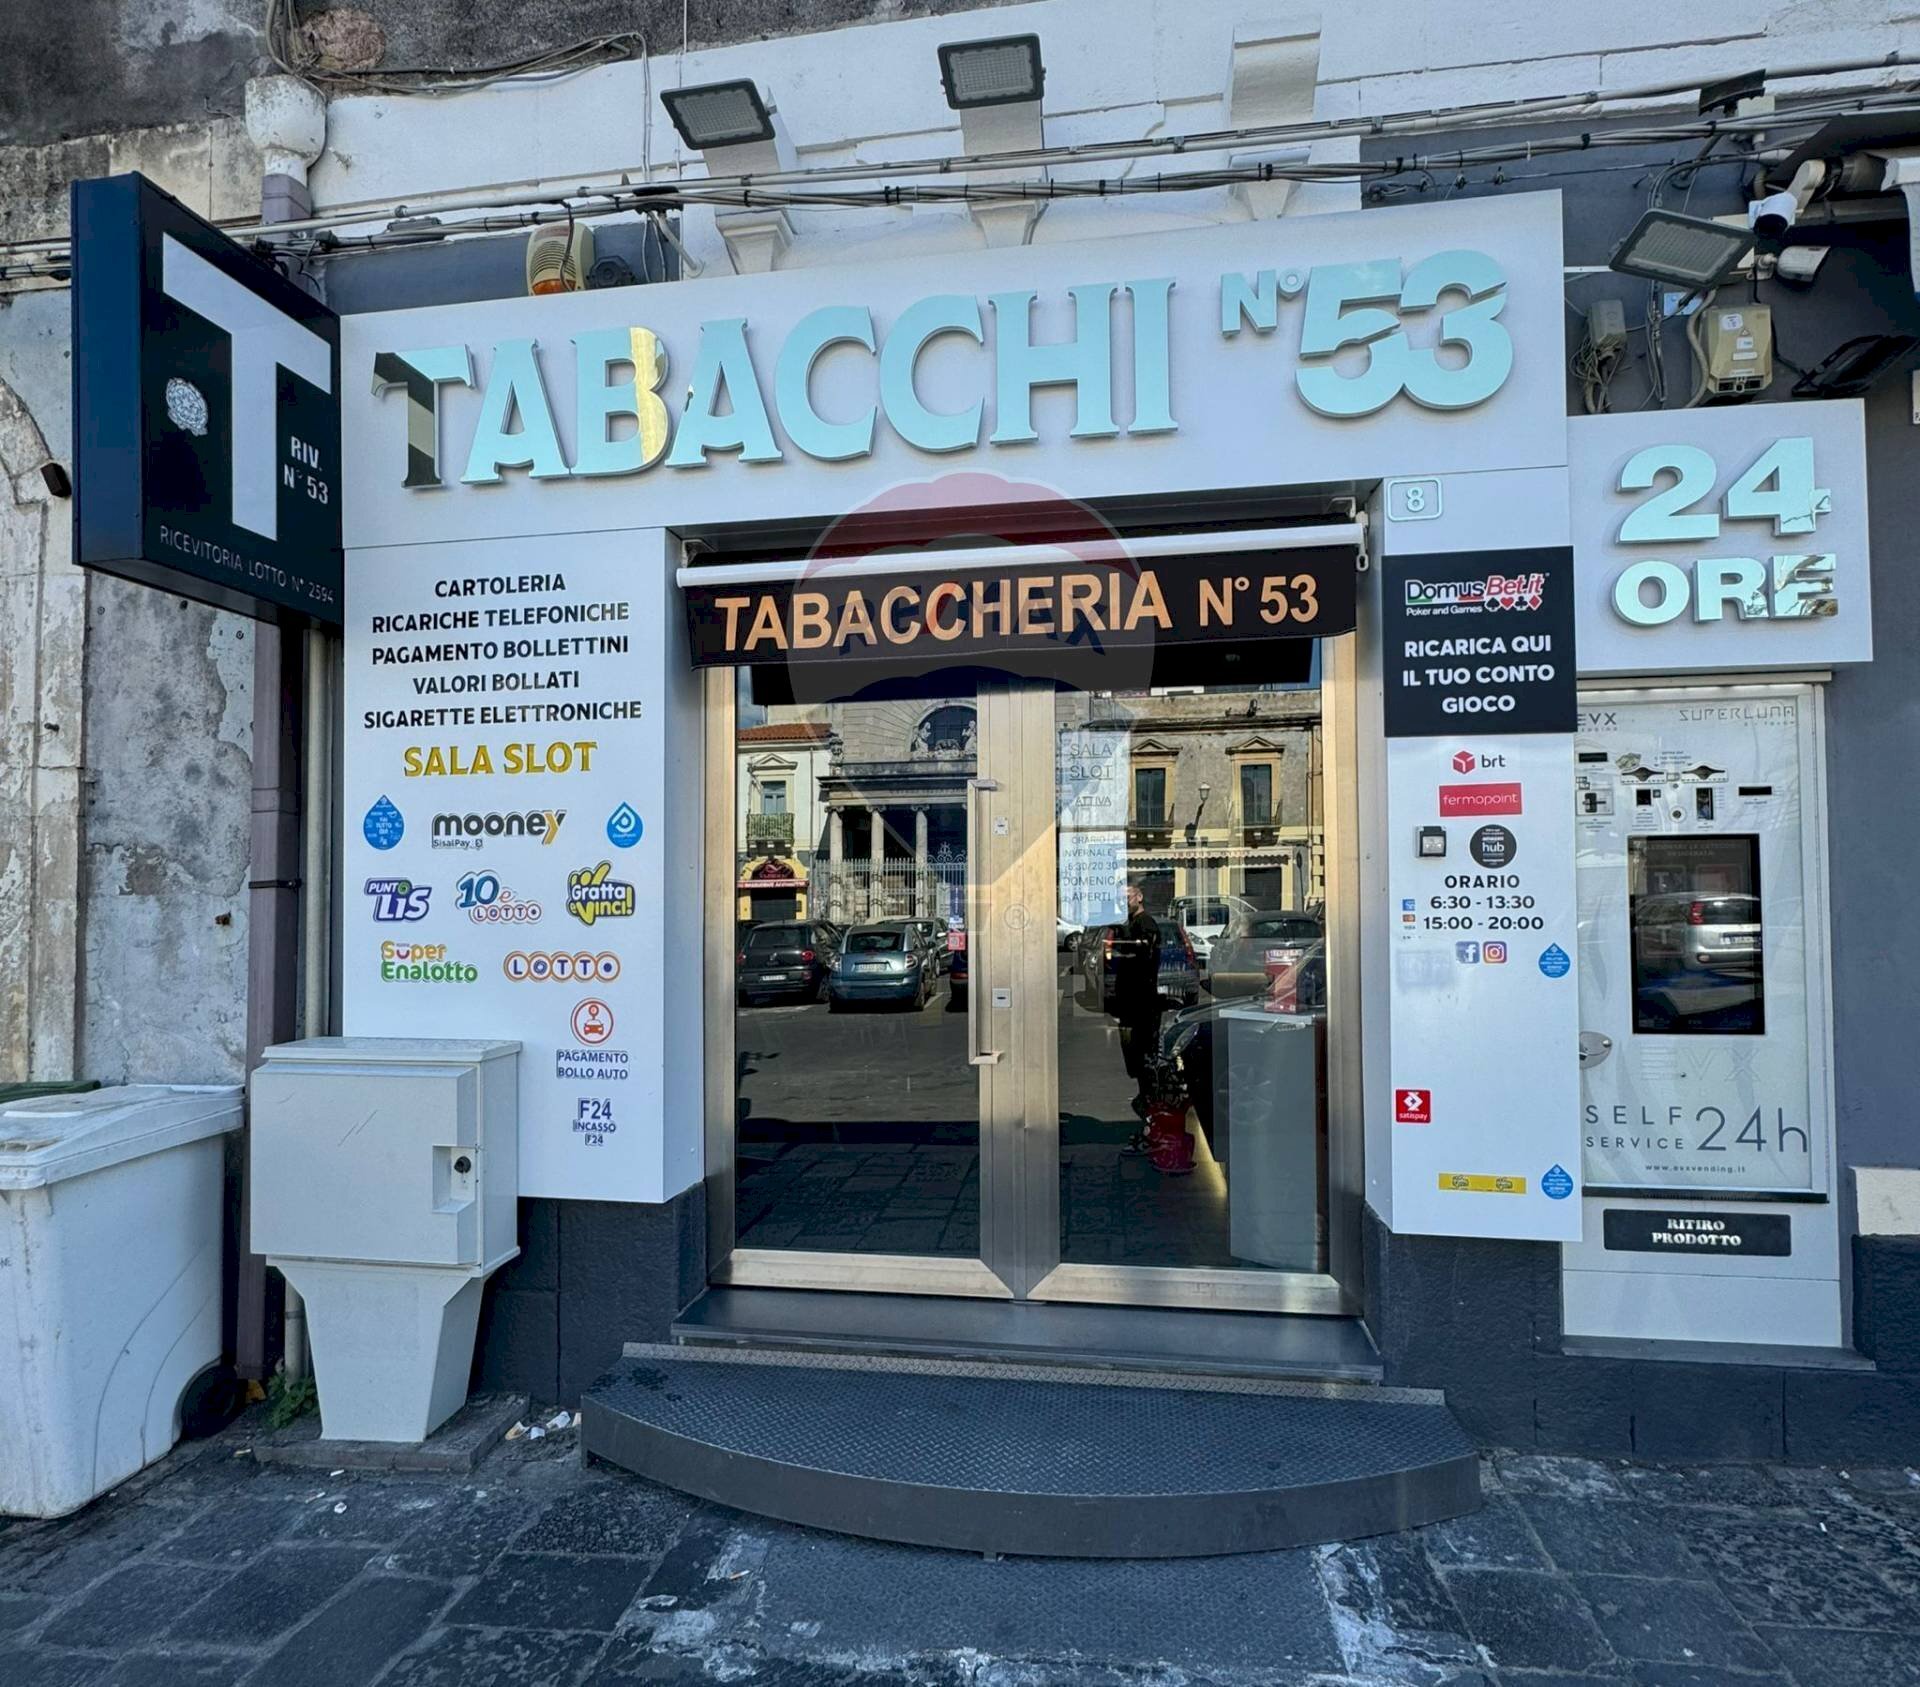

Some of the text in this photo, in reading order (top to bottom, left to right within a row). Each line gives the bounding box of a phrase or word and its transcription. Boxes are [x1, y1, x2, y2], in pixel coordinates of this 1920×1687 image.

[371, 277, 1178, 489] TABACCHI
[291, 435, 322, 471] RIV.
[307, 476, 329, 505] 53
[1405, 487, 1426, 512] 8
[1615, 437, 1832, 545] 24
[160, 525, 243, 572] RICEVITORIA
[249, 559, 287, 588] LOTTO
[435, 574, 566, 597] CARTOLERIA
[1611, 553, 1838, 626] ORE
[372, 602, 629, 633] RICARICHE TELEFONICHE
[714, 570, 1173, 651] TABACCHERIA
[1260, 574, 1319, 624] 53
[1406, 604, 1483, 616] Poker and Games
[372, 635, 629, 665] PAGAMENTO BOLLETTINI
[1404, 634, 1551, 658] RICARICA QUI
[413, 670, 579, 695] VALORI BOLLATI
[1402, 664, 1555, 687] IL TUO CONTO
[364, 701, 642, 729] SIGARETTE ELETTRONICHE
[1441, 695, 1516, 713] GIOCO
[404, 741, 597, 777] SALA SLOT
[1070, 743, 1112, 756] SALA
[1070, 765, 1113, 779] SLOT
[1481, 754, 1506, 768] brt
[1443, 793, 1519, 806] fermopoint
[433, 810, 566, 846] mooney
[1482, 841, 1505, 853] hub
[459, 875, 500, 908] 10
[571, 884, 627, 901] Gratta
[1444, 874, 1520, 889] ORARIO
[1430, 896, 1472, 909] 6:30
[1486, 895, 1535, 909] 13:30
[1423, 916, 1473, 930] 15:00
[1488, 916, 1544, 930] 20:00
[382, 961, 479, 983] Enalotto
[558, 1050, 628, 1063] PAGAMENTO
[558, 1066, 629, 1080] BOLLO AUTO
[579, 1100, 612, 1120] F24
[574, 1121, 617, 1133] INCASSO
[1586, 1105, 1808, 1153] SELF 24h
[585, 1134, 604, 1145] F24
[1586, 1136, 1684, 1150] SERVICE
[1667, 1218, 1725, 1231] RITIRO
[1651, 1232, 1742, 1246] PRODOTTO
